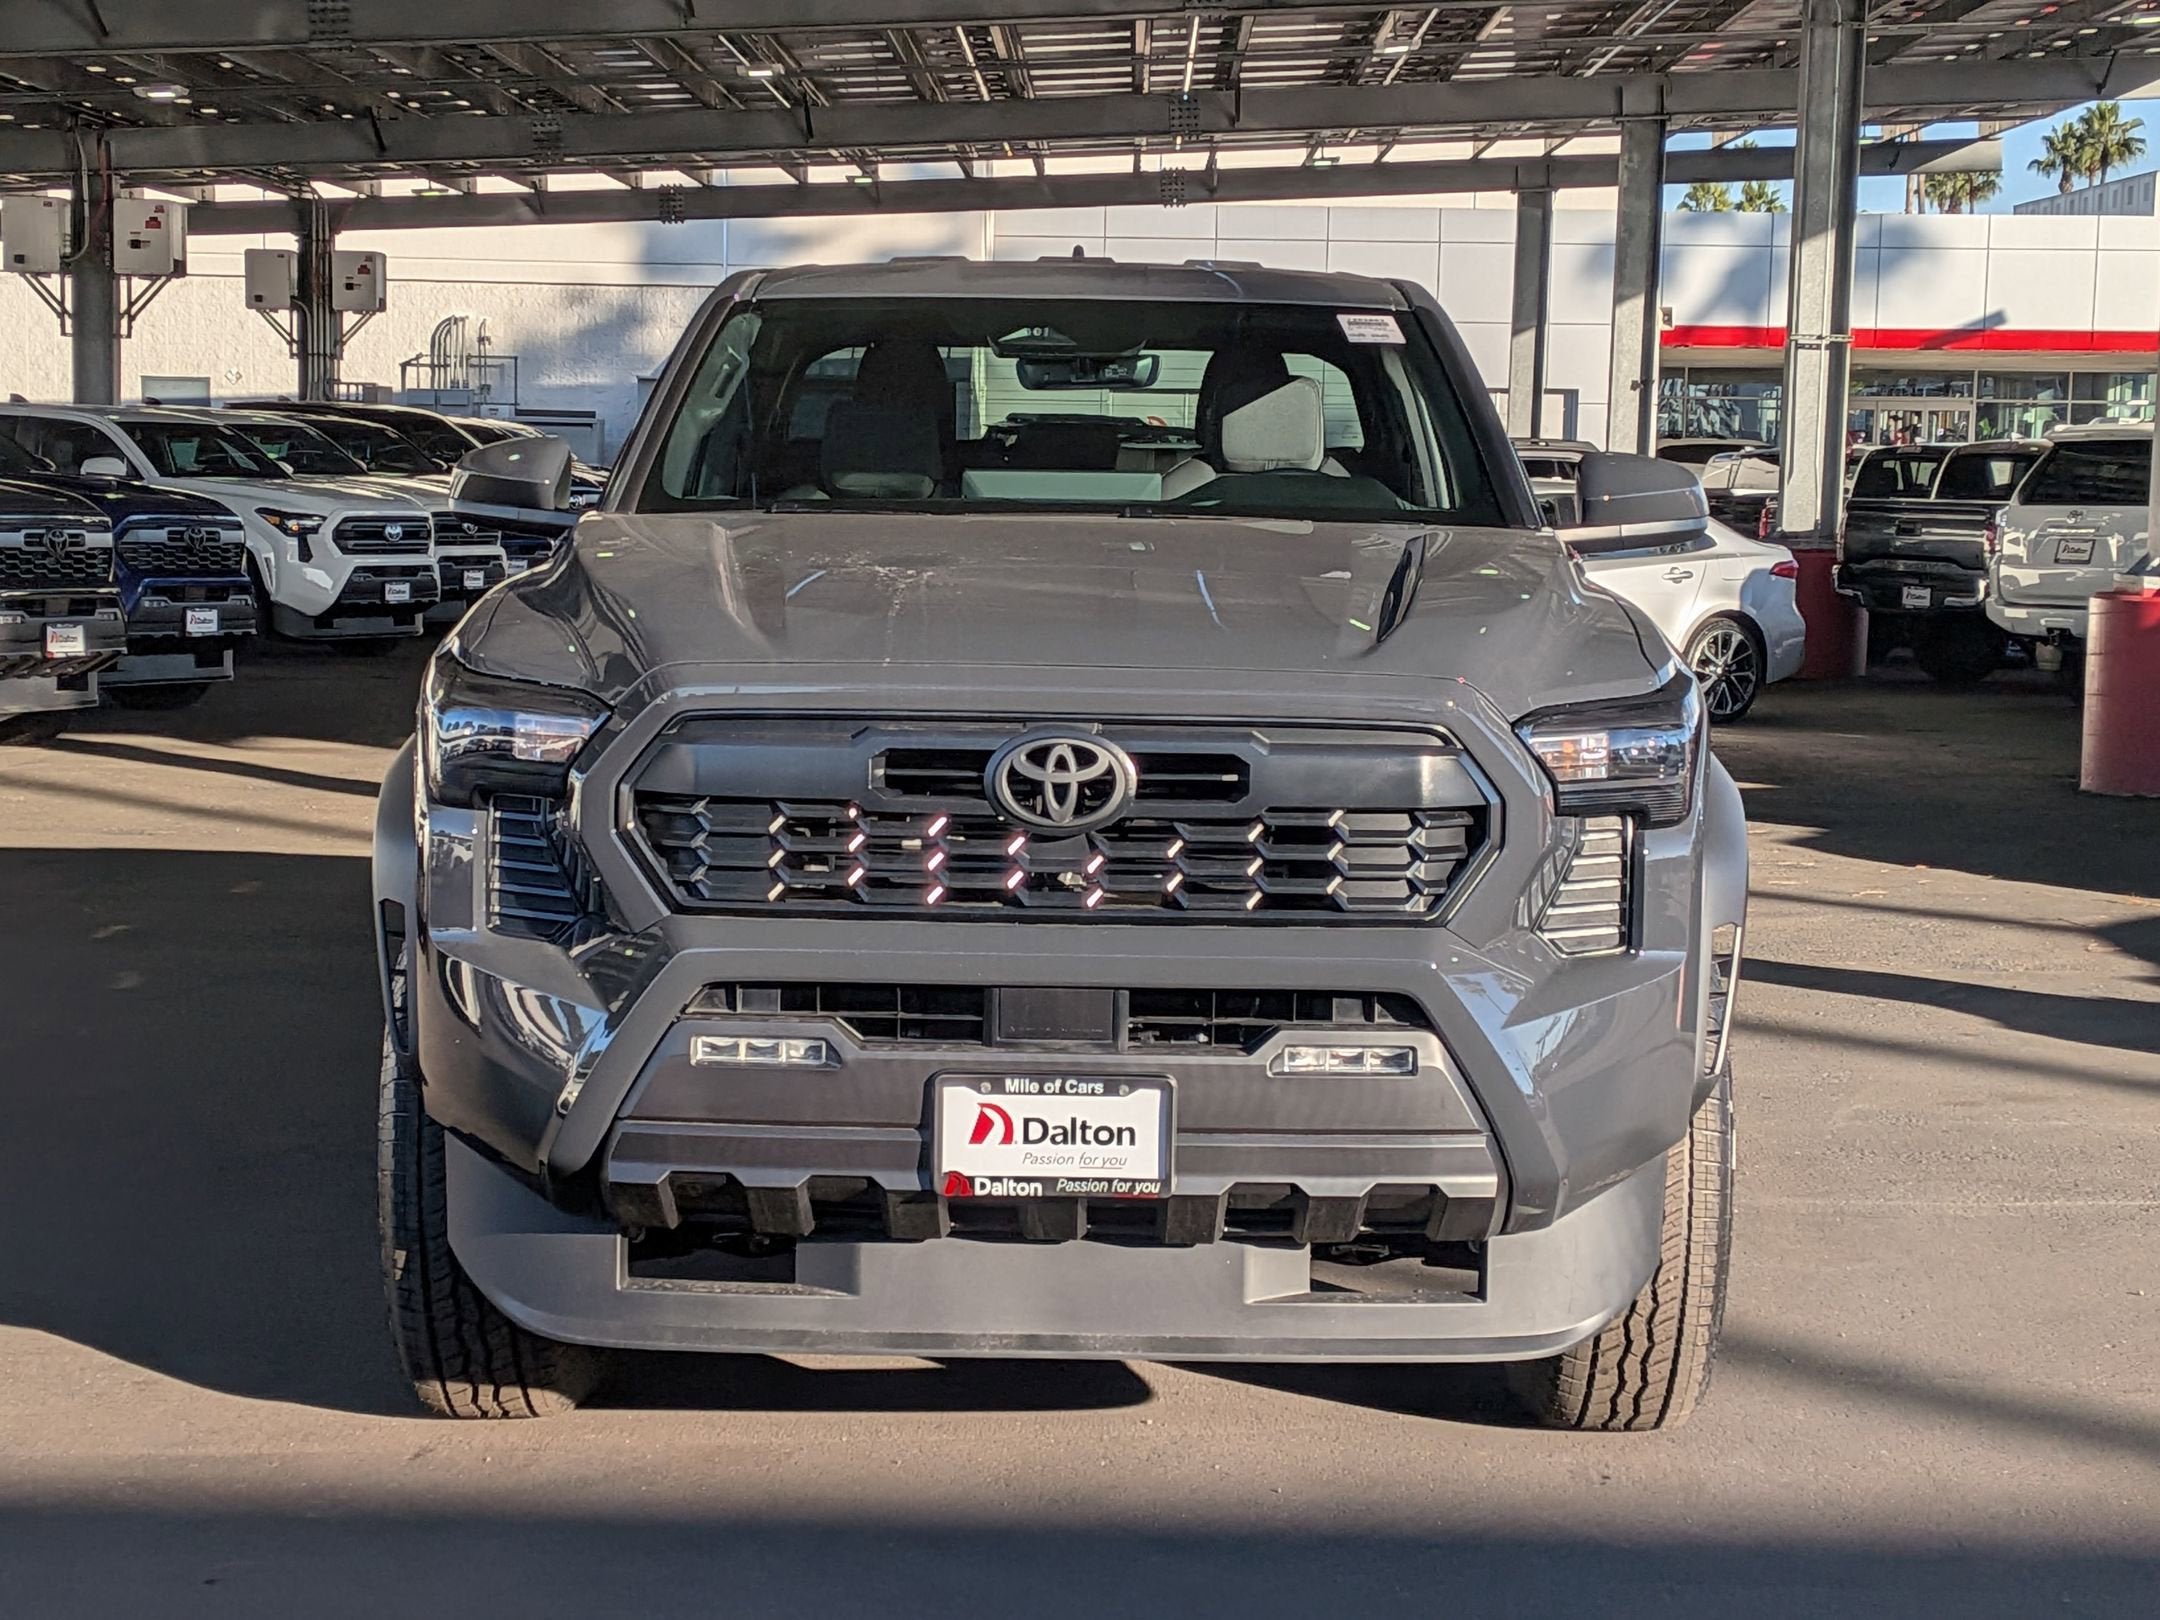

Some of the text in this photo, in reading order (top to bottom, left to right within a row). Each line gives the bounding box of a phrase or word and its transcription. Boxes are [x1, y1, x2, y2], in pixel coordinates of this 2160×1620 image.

[1043, 1079, 1062, 1094] of
[1064, 1079, 1105, 1095] Cars
[1022, 1117, 1136, 1146] Dalton
[1022, 1152, 1128, 1169] Passion for you
[974, 1177, 1042, 1197] Dalton
[1056, 1179, 1161, 1196] Passion for you
